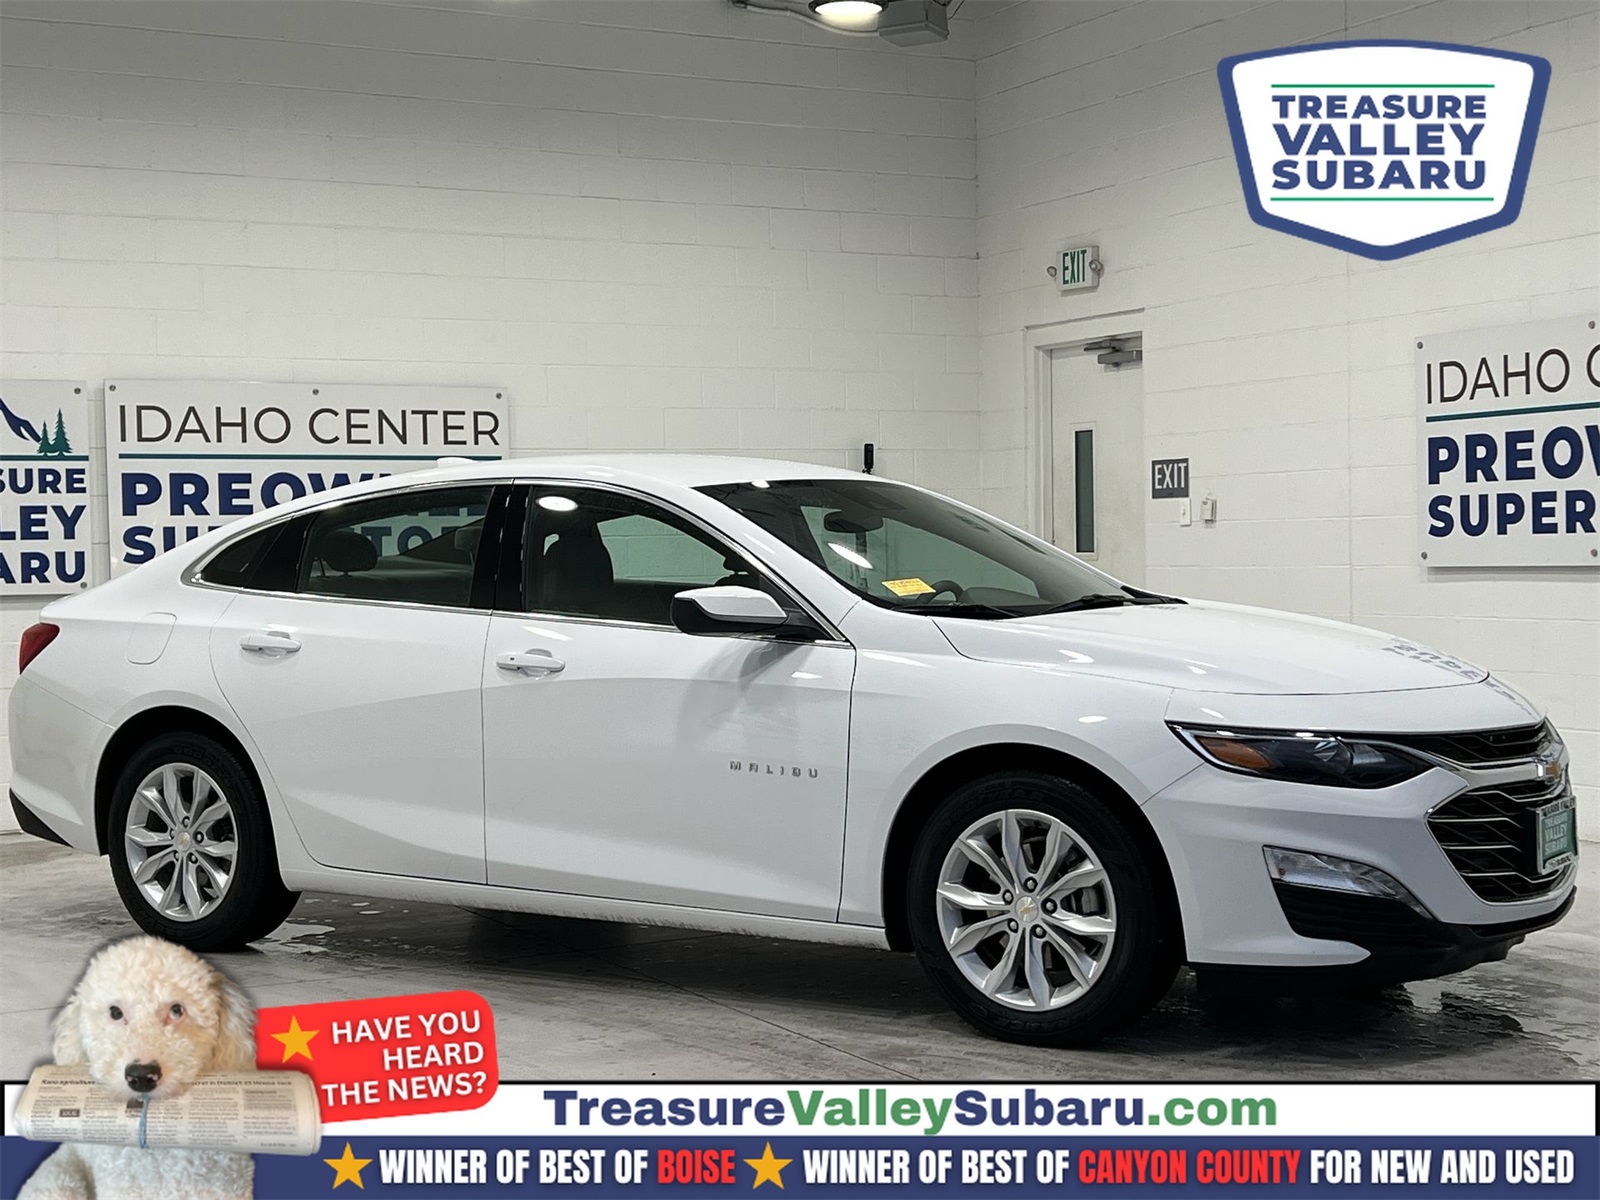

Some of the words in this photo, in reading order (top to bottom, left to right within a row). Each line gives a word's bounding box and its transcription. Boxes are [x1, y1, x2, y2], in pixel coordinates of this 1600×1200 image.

[1062, 249, 1087, 285] EXIT
[1426, 348, 1570, 404] IDAHO
[119, 405, 291, 443] IDAHO
[308, 408, 500, 446] CENTER
[0, 468, 87, 495] URE
[1154, 463, 1187, 489] EXIT
[729, 760, 818, 779] MALIBU
